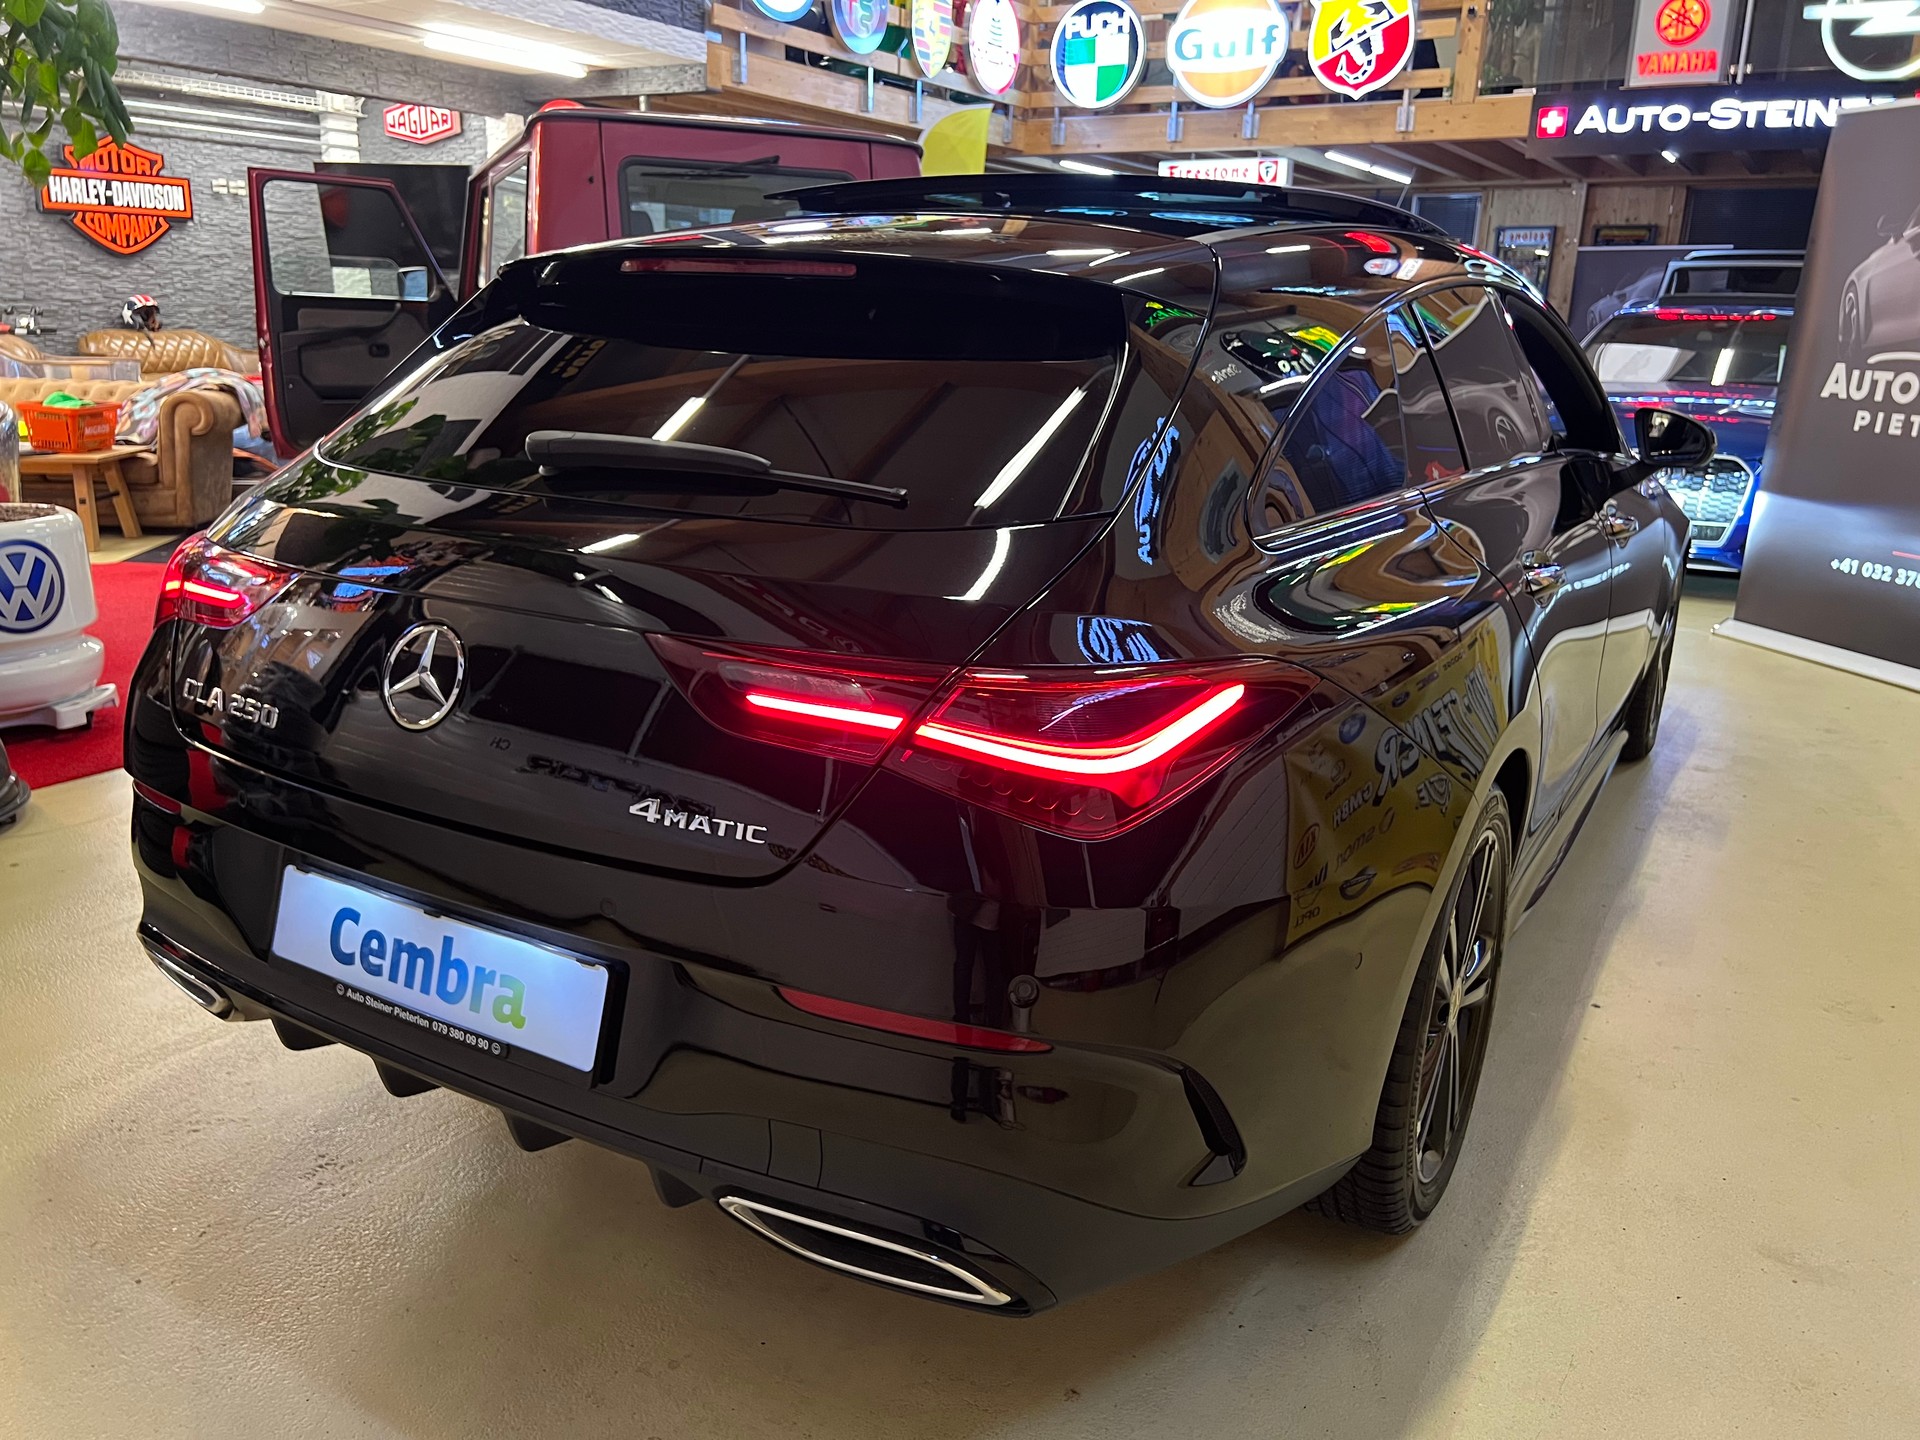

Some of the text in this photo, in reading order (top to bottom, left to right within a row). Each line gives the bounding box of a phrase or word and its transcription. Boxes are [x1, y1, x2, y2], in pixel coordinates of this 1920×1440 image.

[1065, 11, 1131, 40] PUCH
[1174, 24, 1280, 61] Gulf
[1637, 50, 1717, 76] YAMAHA
[388, 106, 449, 135] JAGUAR
[1573, 97, 1897, 135] AUTO-STEIN
[79, 142, 151, 176] MOTOR
[1167, 165, 1249, 180] Firestone
[48, 175, 186, 212] HARLEY-DAVIDSON
[85, 212, 158, 248] COMPANY
[1830, 557, 1860, 575] +41
[1861, 561, 1893, 582] 032
[183, 677, 280, 729] CLA 250
[628, 797, 768, 845] 4MATIC
[329, 906, 527, 1031] Cembra
[346, 987, 365, 1003] Auto
[365, 995, 394, 1015] Steiner
[432, 1020, 448, 1035] 079
[465, 1035, 476, 1046] 09
[477, 1038, 489, 1051] 90
